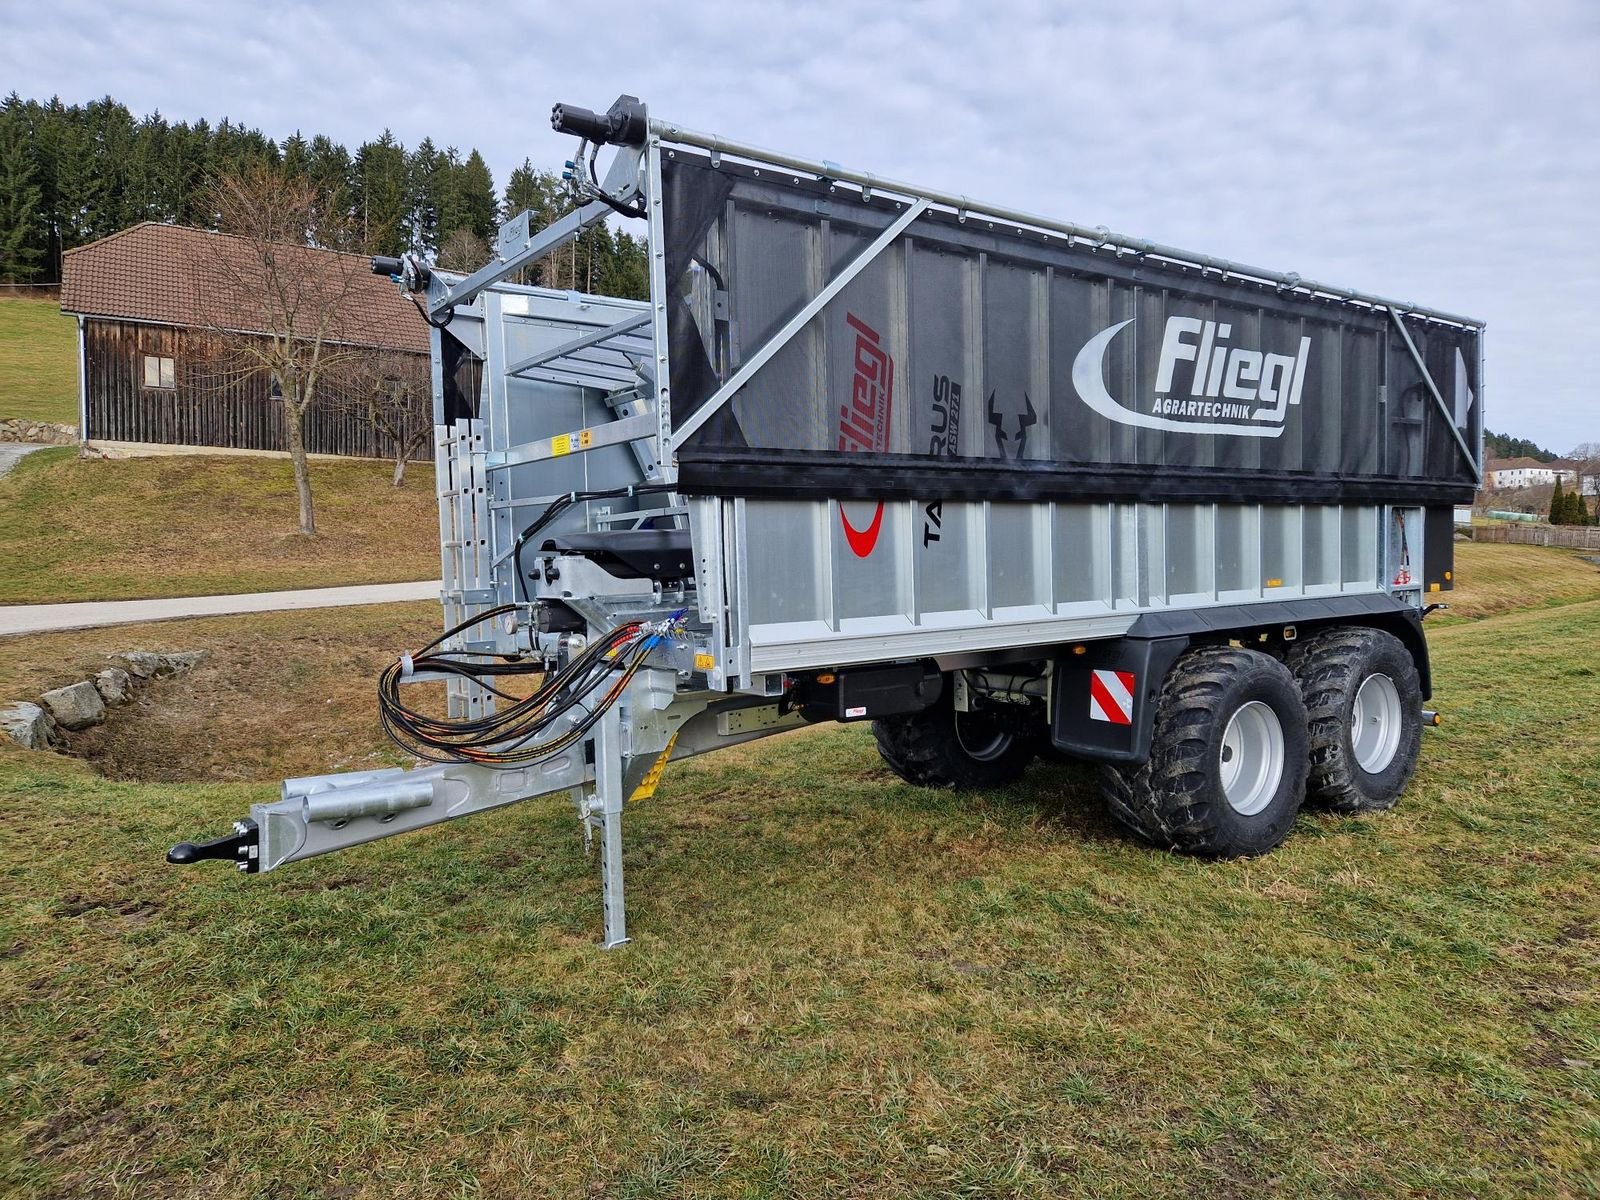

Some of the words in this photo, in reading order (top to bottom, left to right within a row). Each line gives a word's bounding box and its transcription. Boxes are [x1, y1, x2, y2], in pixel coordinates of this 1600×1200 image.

[1155, 316, 1311, 422] Fliegl
[950, 392, 961, 419] 271
[1152, 398, 1250, 420] AGRARTECHNIK
[948, 420, 958, 453] ASW
